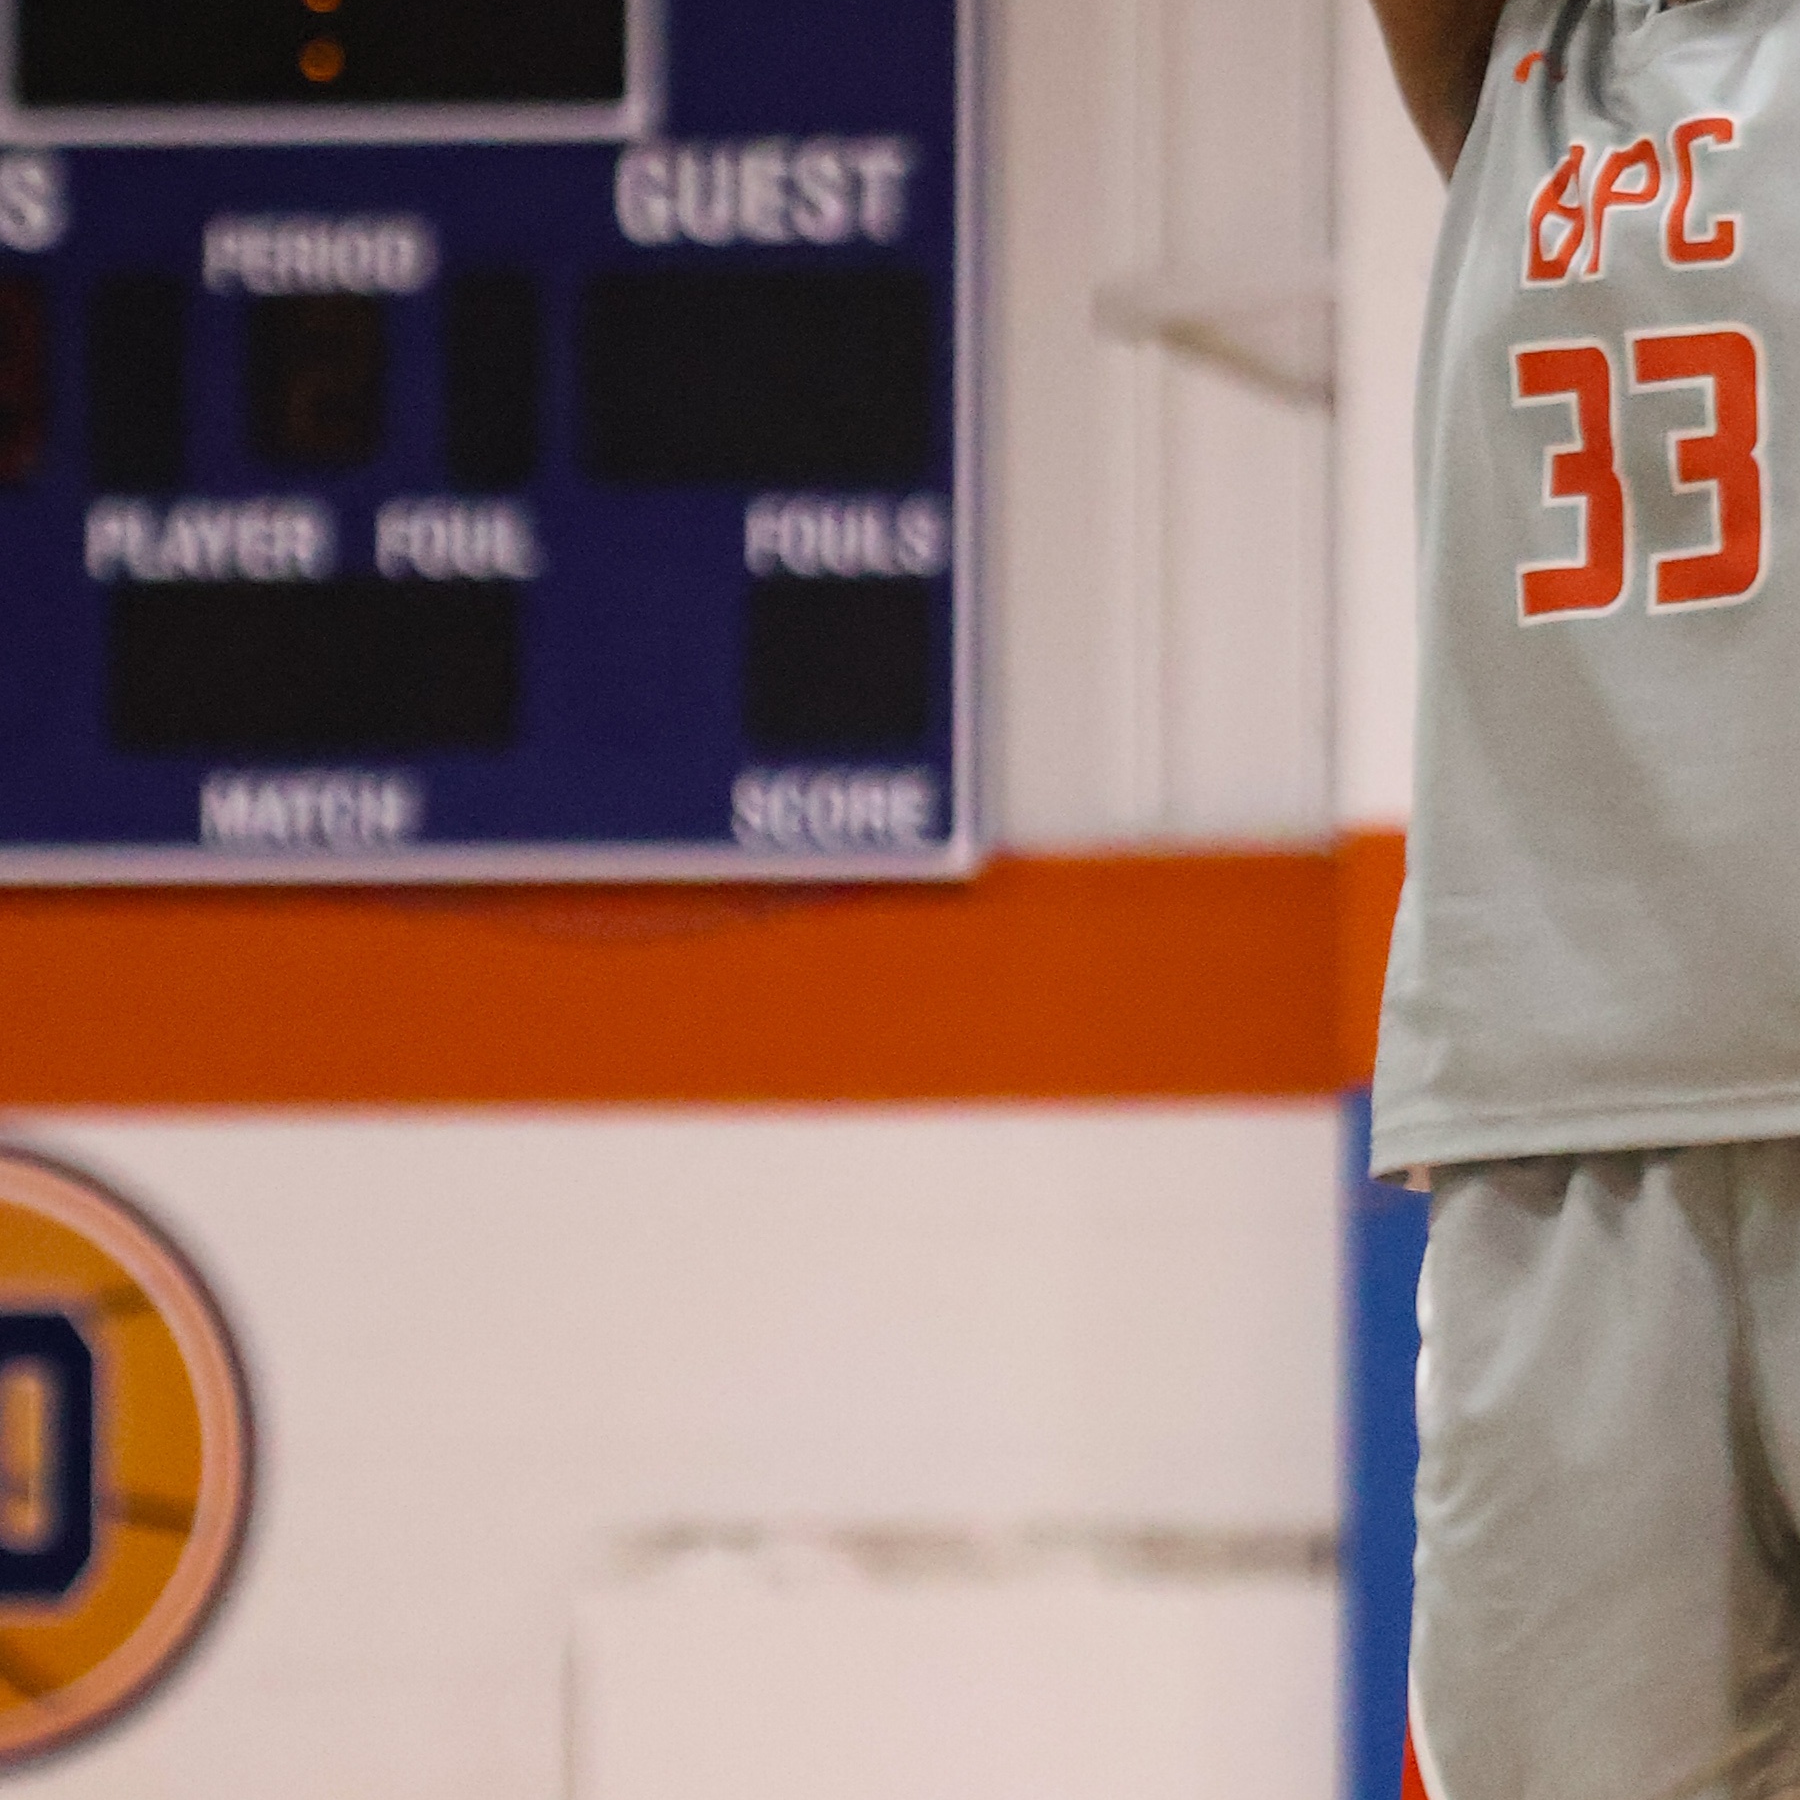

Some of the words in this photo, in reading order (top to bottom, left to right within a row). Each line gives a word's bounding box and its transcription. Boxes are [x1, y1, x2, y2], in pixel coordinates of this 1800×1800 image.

[612, 135, 908, 247] GUEST
[202, 211, 434, 295] PERIOD
[1511, 323, 1768, 623] 33
[84, 494, 335, 581] PLAYER
[374, 495, 542, 581] FOUL
[743, 491, 946, 579] FOULS
[202, 769, 422, 849] MATCH
[730, 765, 938, 851] SCORE
